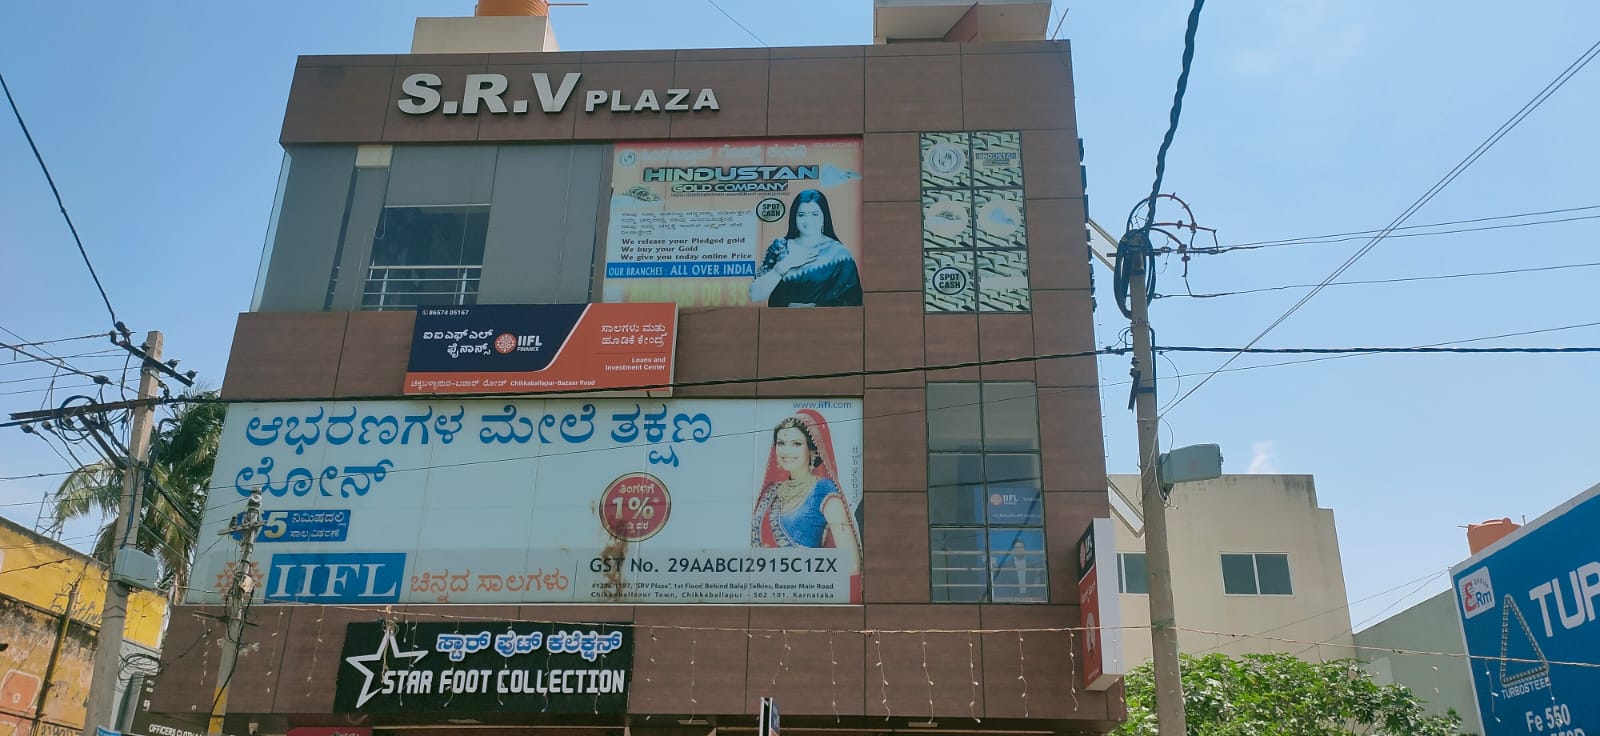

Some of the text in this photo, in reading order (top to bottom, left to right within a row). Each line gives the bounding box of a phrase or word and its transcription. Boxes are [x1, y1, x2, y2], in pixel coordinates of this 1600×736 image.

[397, 72, 720, 115] S.R.V PLAZA
[643, 165, 820, 183] HINDUSTAN
[671, 183, 713, 194] GOLD
[714, 182, 789, 193] COMPANY
[761, 209, 781, 217] CASH
[668, 239, 688, 247] your
[691, 237, 724, 246] Pledged
[727, 237, 746, 246] gold
[637, 246, 653, 254] buy
[675, 253, 699, 261] today
[731, 252, 753, 260] Price
[608, 267, 624, 276] OUR
[626, 266, 664, 276] BRANCHES
[670, 264, 690, 276] ALL
[692, 263, 721, 275] OVER
[723, 263, 753, 275] INDIA
[939, 273, 960, 281] SPOT
[938, 281, 961, 289] CASH
[517, 335, 543, 346] IIFL
[792, 401, 852, 409] www.iifl.com
[246, 403, 712, 467] ಆಭರಣಗಳ ಮೇಲೆ ತಕ್ಷಣ
[235, 456, 394, 498] ಲೋನ್
[589, 557, 625, 573] GST
[630, 557, 659, 573] No.
[269, 563, 397, 598] IIFL
[410, 567, 569, 602] ಚಿನ್ನದ ಸಾಲಗಳು
[729, 582, 748, 591] Balaji
[546, 630, 623, 662] ಕಲೆಕ್ಷನ್
[381, 669, 625, 694] STAR FOOT COLLECTION
[1501, 677, 1552, 700] TURBOSTEEL
[1525, 703, 1571, 733] Fe 550
